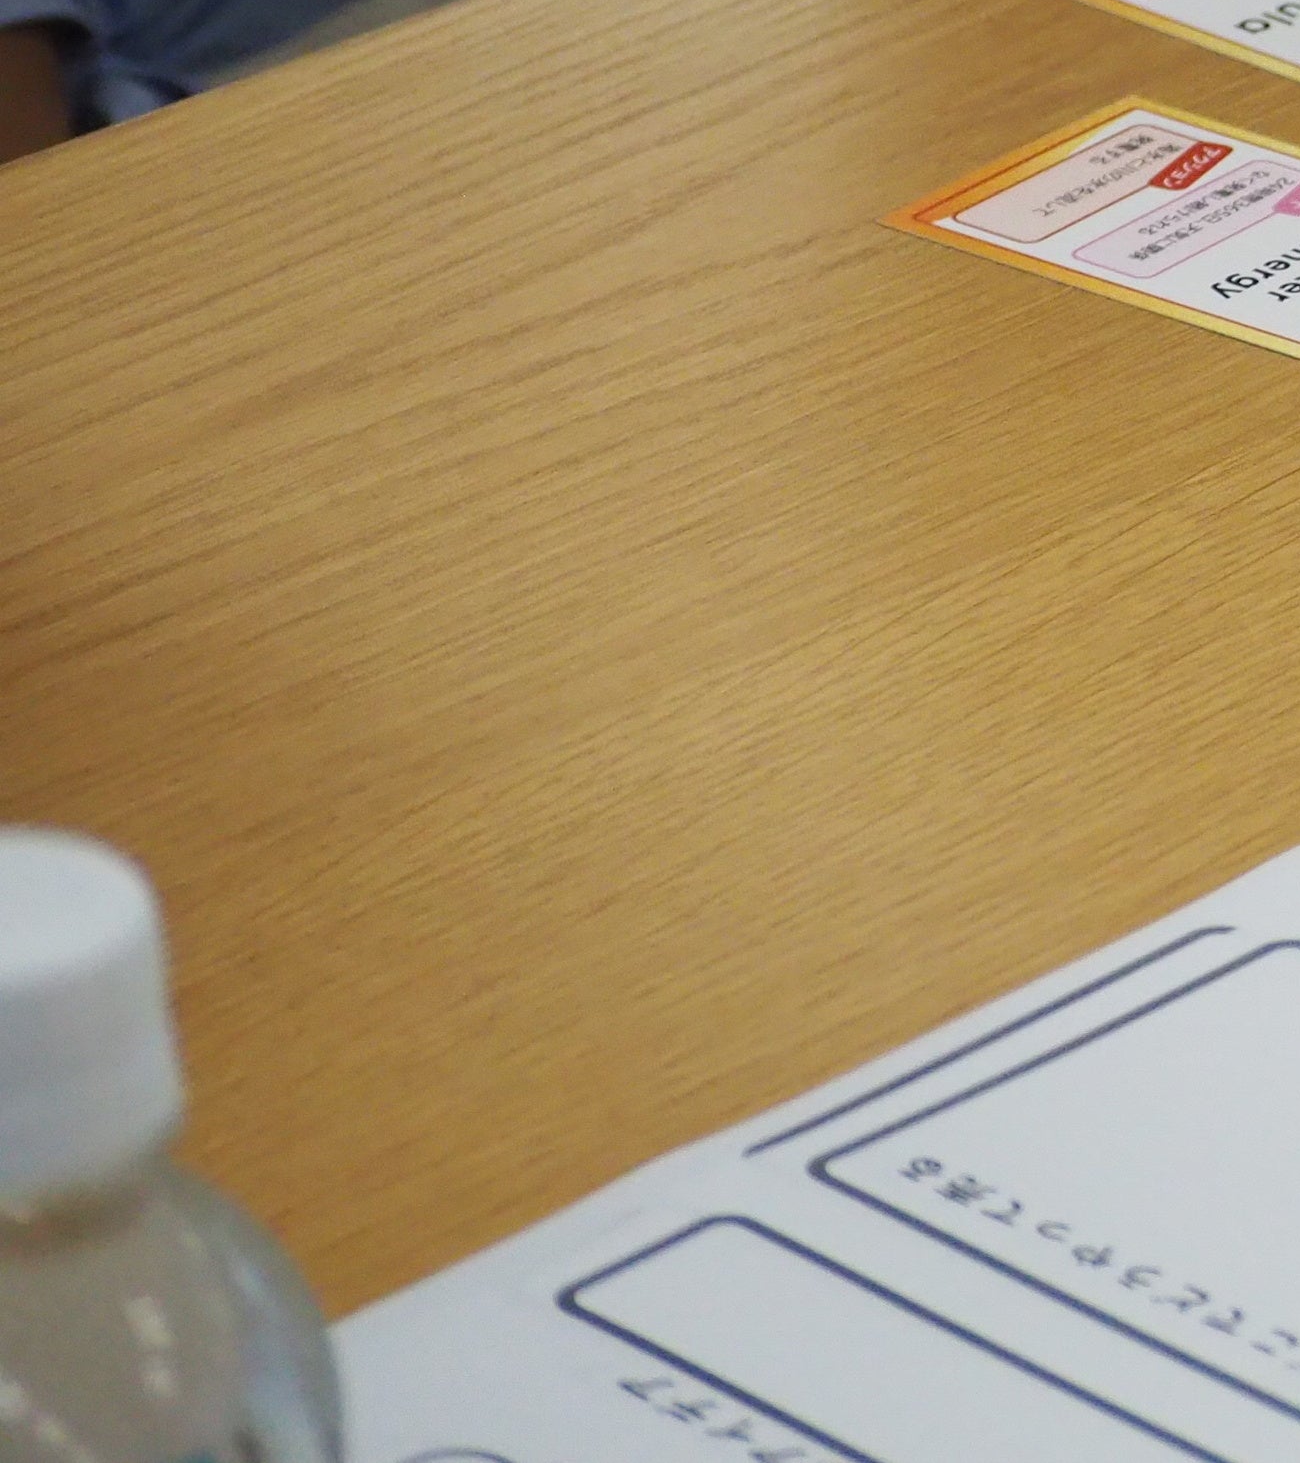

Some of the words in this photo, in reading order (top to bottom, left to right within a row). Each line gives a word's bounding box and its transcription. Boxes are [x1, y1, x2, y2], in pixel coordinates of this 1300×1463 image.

[1163, 147, 1221, 187] アクション
